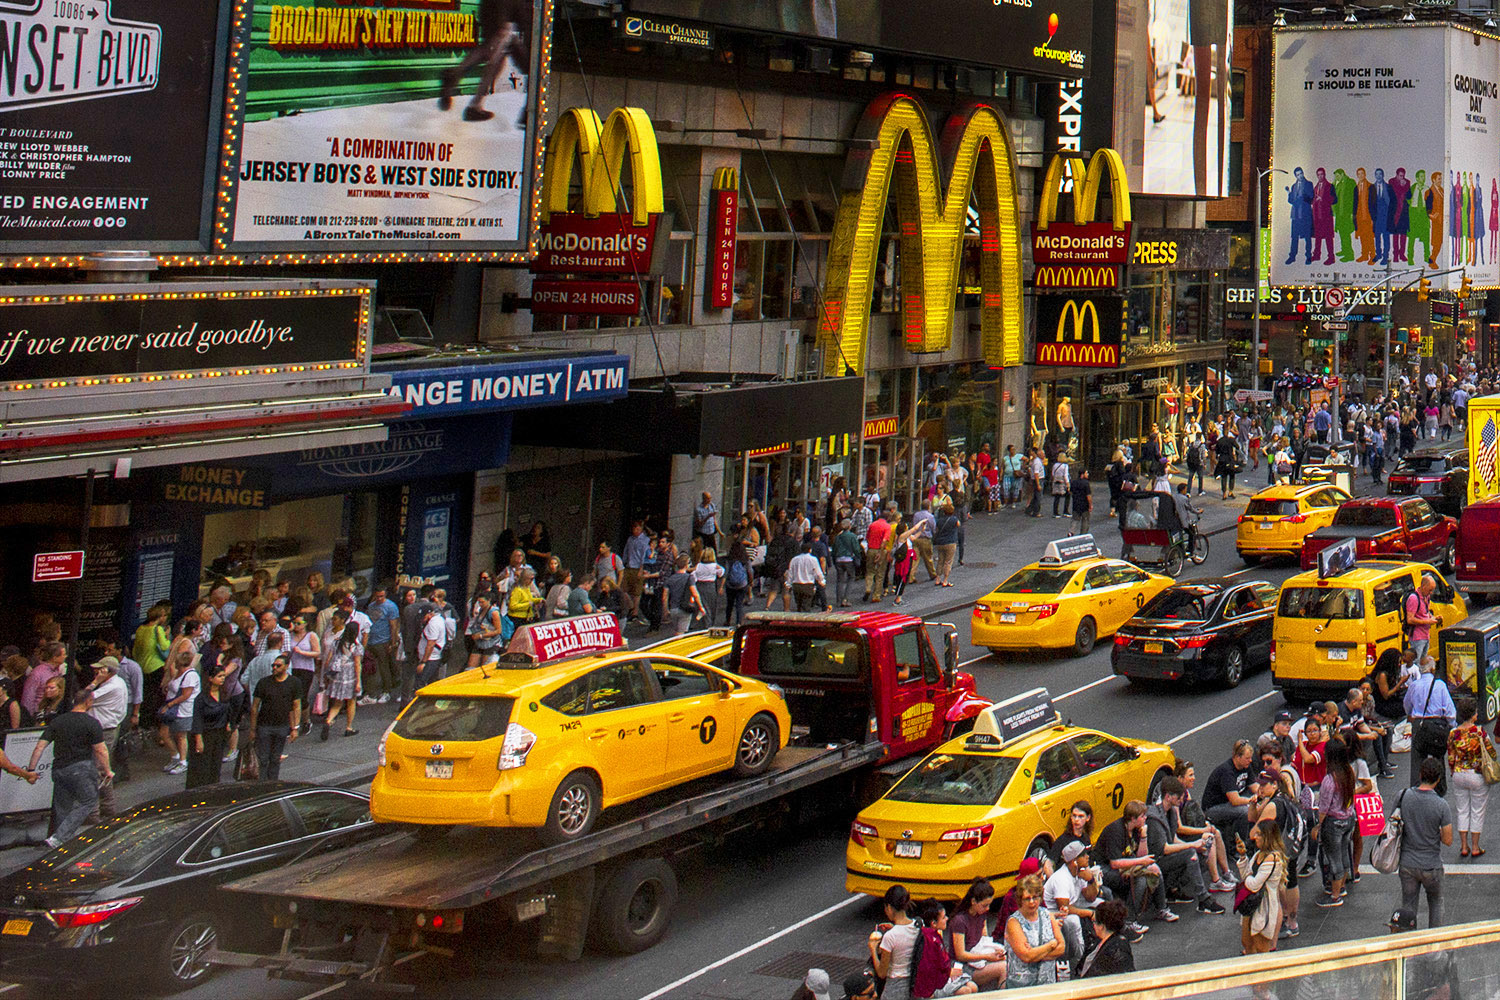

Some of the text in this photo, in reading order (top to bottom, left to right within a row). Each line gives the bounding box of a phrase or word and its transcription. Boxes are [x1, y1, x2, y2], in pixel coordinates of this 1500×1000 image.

[53, 0, 85, 20] 10086
[269, 5, 475, 44] BROADWAY'S NEW HIT MUSICAL
[670, 34, 709, 46] SPECTACOLOR
[97, 29, 154, 87] BLVD.
[1343, 67, 1394, 77] MUCH FUN
[1304, 80, 1371, 90] IT SHOULD BE
[1454, 74, 1498, 99] GROUNDHOG
[1469, 96, 1483, 113] DAY
[9, 128, 73, 140] BOULEVARD
[21, 143, 89, 153] LLOYD WEBBER
[343, 138, 453, 161] COMBINATION OF
[20, 152, 131, 163] CHRISTOPHER HAMPTON
[27, 161, 61, 170] WILDER
[2, 170, 66, 179] LONNY PRICE
[240, 161, 464, 187] JERSEY BOYS WEST SIDE
[32, 195, 149, 210] ENGAGEMENT
[253, 216, 317, 227] TELECHARGE.COM
[303, 229, 461, 240] ABronxTaleTheMusical.com
[539, 234, 646, 252] McDonald's
[1036, 235, 1125, 249] McDonald's
[550, 255, 626, 267] Restaurant
[1050, 251, 1109, 260] Restaurant
[534, 291, 635, 304] OPEN 24 HOURS
[0, 319, 295, 365] if we never said goodbye.
[471, 367, 624, 402] MONEY ATM
[1102, 382, 1130, 395] EXPRESS
[1142, 377, 1169, 389] EXPRESS
[181, 466, 247, 486] MONEY
[165, 485, 265, 507] EXCHANGE
[47, 554, 72, 562] STANDING
[534, 614, 616, 641] BETTE MIDLER
[544, 632, 614, 659] HELLO, DOLLY!
[560, 720, 582, 732] 7M29
[1355, 796, 1382, 813] THE
